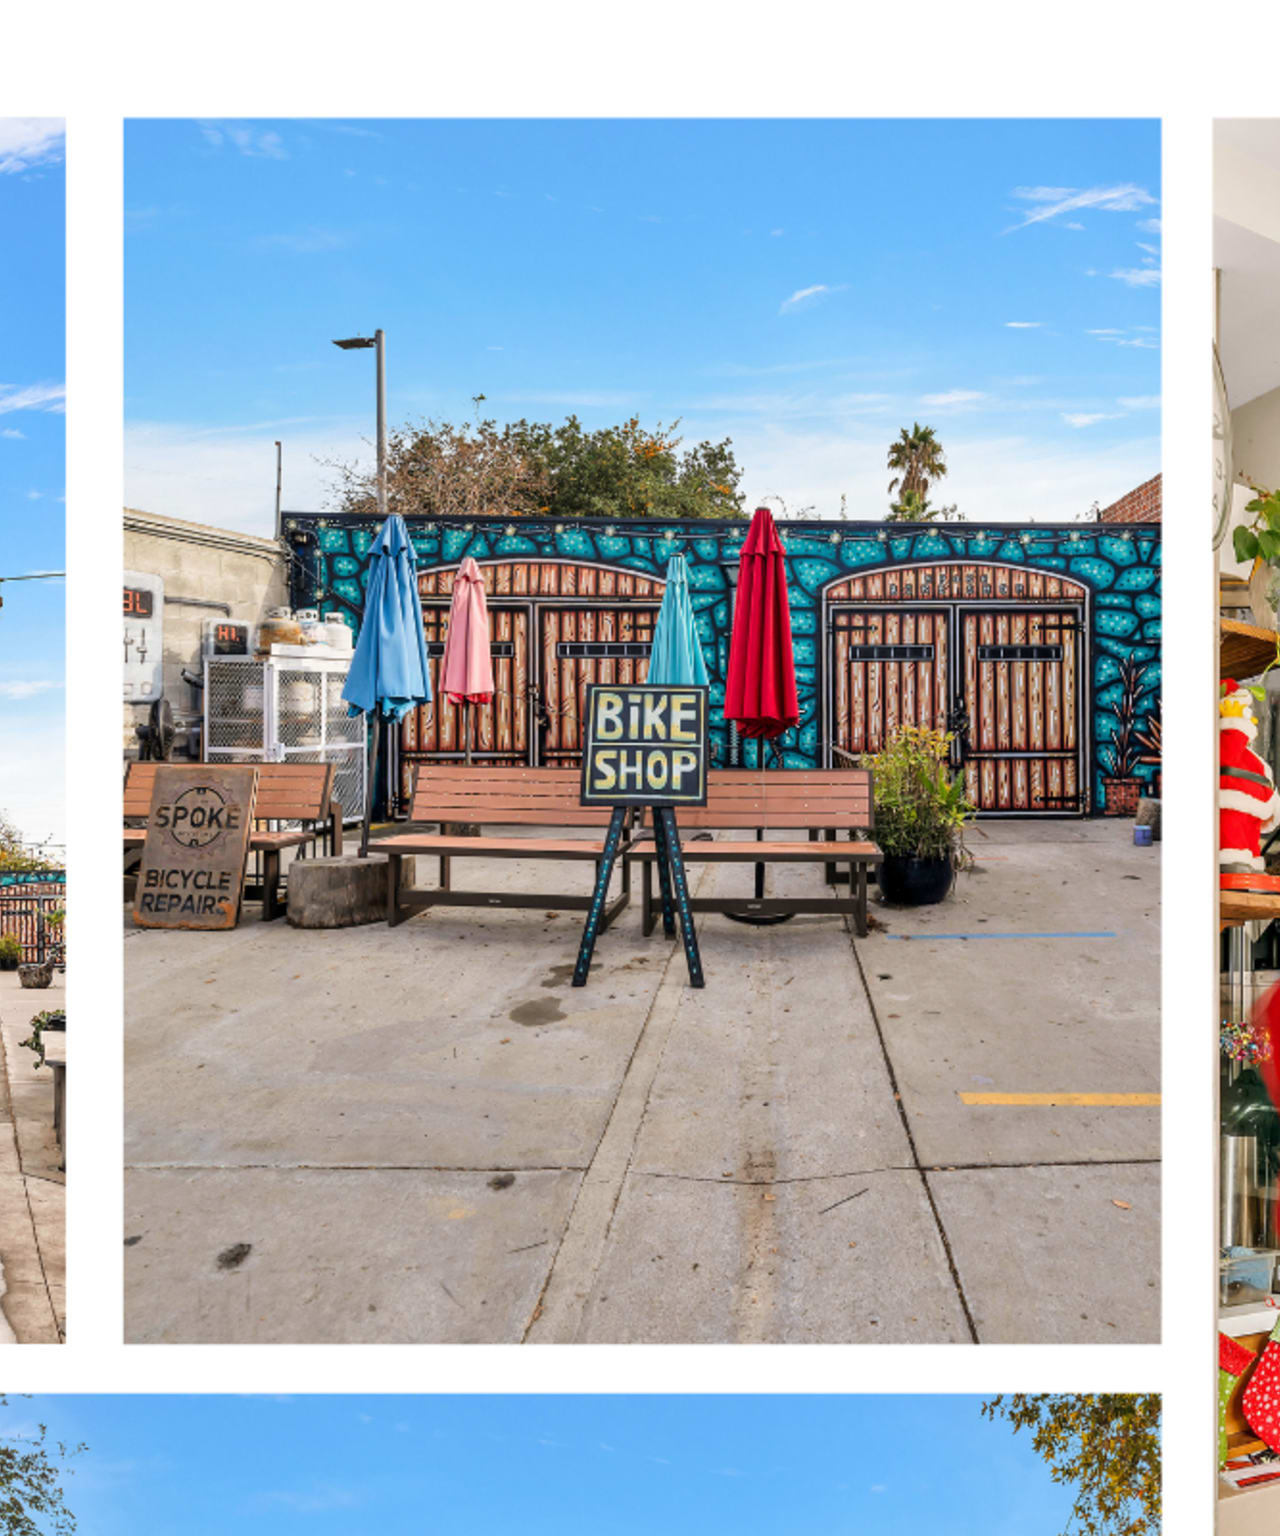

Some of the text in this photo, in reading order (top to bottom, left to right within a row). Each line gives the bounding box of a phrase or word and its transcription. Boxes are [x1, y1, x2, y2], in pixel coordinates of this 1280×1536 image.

[593, 749, 698, 790] SHOP
[154, 805, 241, 830] SPOKE
[144, 869, 232, 891] BICYCLE
[140, 892, 231, 917] REPAIRS
